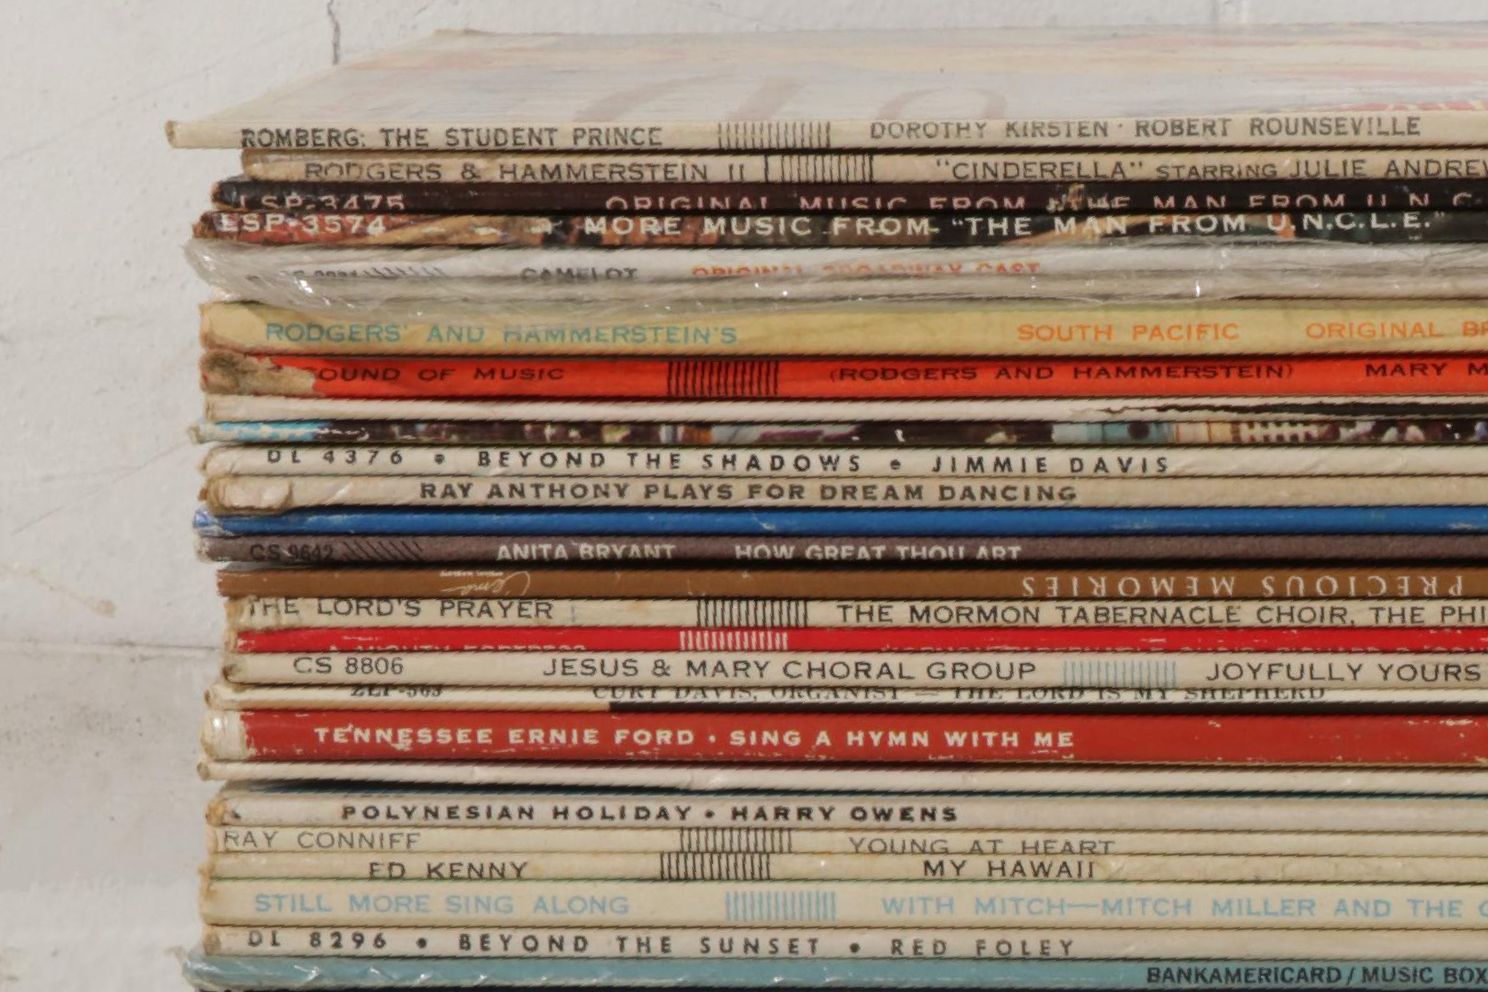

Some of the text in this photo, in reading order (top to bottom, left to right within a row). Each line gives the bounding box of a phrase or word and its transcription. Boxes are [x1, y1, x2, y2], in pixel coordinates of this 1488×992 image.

[378, 127, 428, 147] THE
[445, 128, 561, 147] STUDENT
[572, 128, 663, 147] PRINCE
[871, 121, 987, 141] DOROTHY
[1004, 121, 1108, 139] KIRSTEN
[1134, 119, 1231, 138] ROBERT
[1249, 116, 1421, 137] ROUNSEVILLE
[220, 215, 388, 234] LSP-3574
[584, 216, 681, 236] MORE
[703, 217, 811, 236] MUSIC
[832, 218, 930, 236] FROM
[1054, 215, 1128, 234] MAN
[1149, 214, 1246, 234] FROM
[1018, 322, 1114, 341] SOUTH
[1132, 322, 1240, 341] PACIFIC
[1305, 321, 1444, 339] ORIGINAL
[1364, 361, 1448, 378] MARY
[1021, 575, 1236, 598] MEMORIES
[1261, 575, 1464, 596] PRECIOUS
[316, 601, 421, 618] LORD'S
[439, 601, 554, 619] PRAYER
[836, 605, 892, 624] THE
[908, 606, 1040, 624] MORMON
[1056, 606, 1241, 624] TABERNACLE
[1370, 606, 1424, 624] THE
[314, 725, 494, 746] TENNESSEE
[509, 728, 599, 745] ERNIE
[614, 729, 695, 745] FORD
[730, 730, 801, 746] SING
[815, 731, 832, 746] A
[846, 731, 929, 748] HYMN
[945, 731, 1020, 748] WITH
[1034, 732, 1074, 748] ME
[341, 805, 535, 820] POLYNESIAN
[552, 806, 692, 821] HOLIDAY
[731, 806, 836, 822] HARRY
[850, 806, 959, 823] OWENS
[255, 894, 331, 912] STILL
[349, 895, 432, 912] MORE
[446, 895, 515, 914] SING
[534, 895, 630, 915] ALONG
[881, 896, 955, 916] WITH
[1211, 898, 1318, 918] MILLER
[1334, 898, 1391, 918] AND
[1407, 898, 1461, 918] THE
